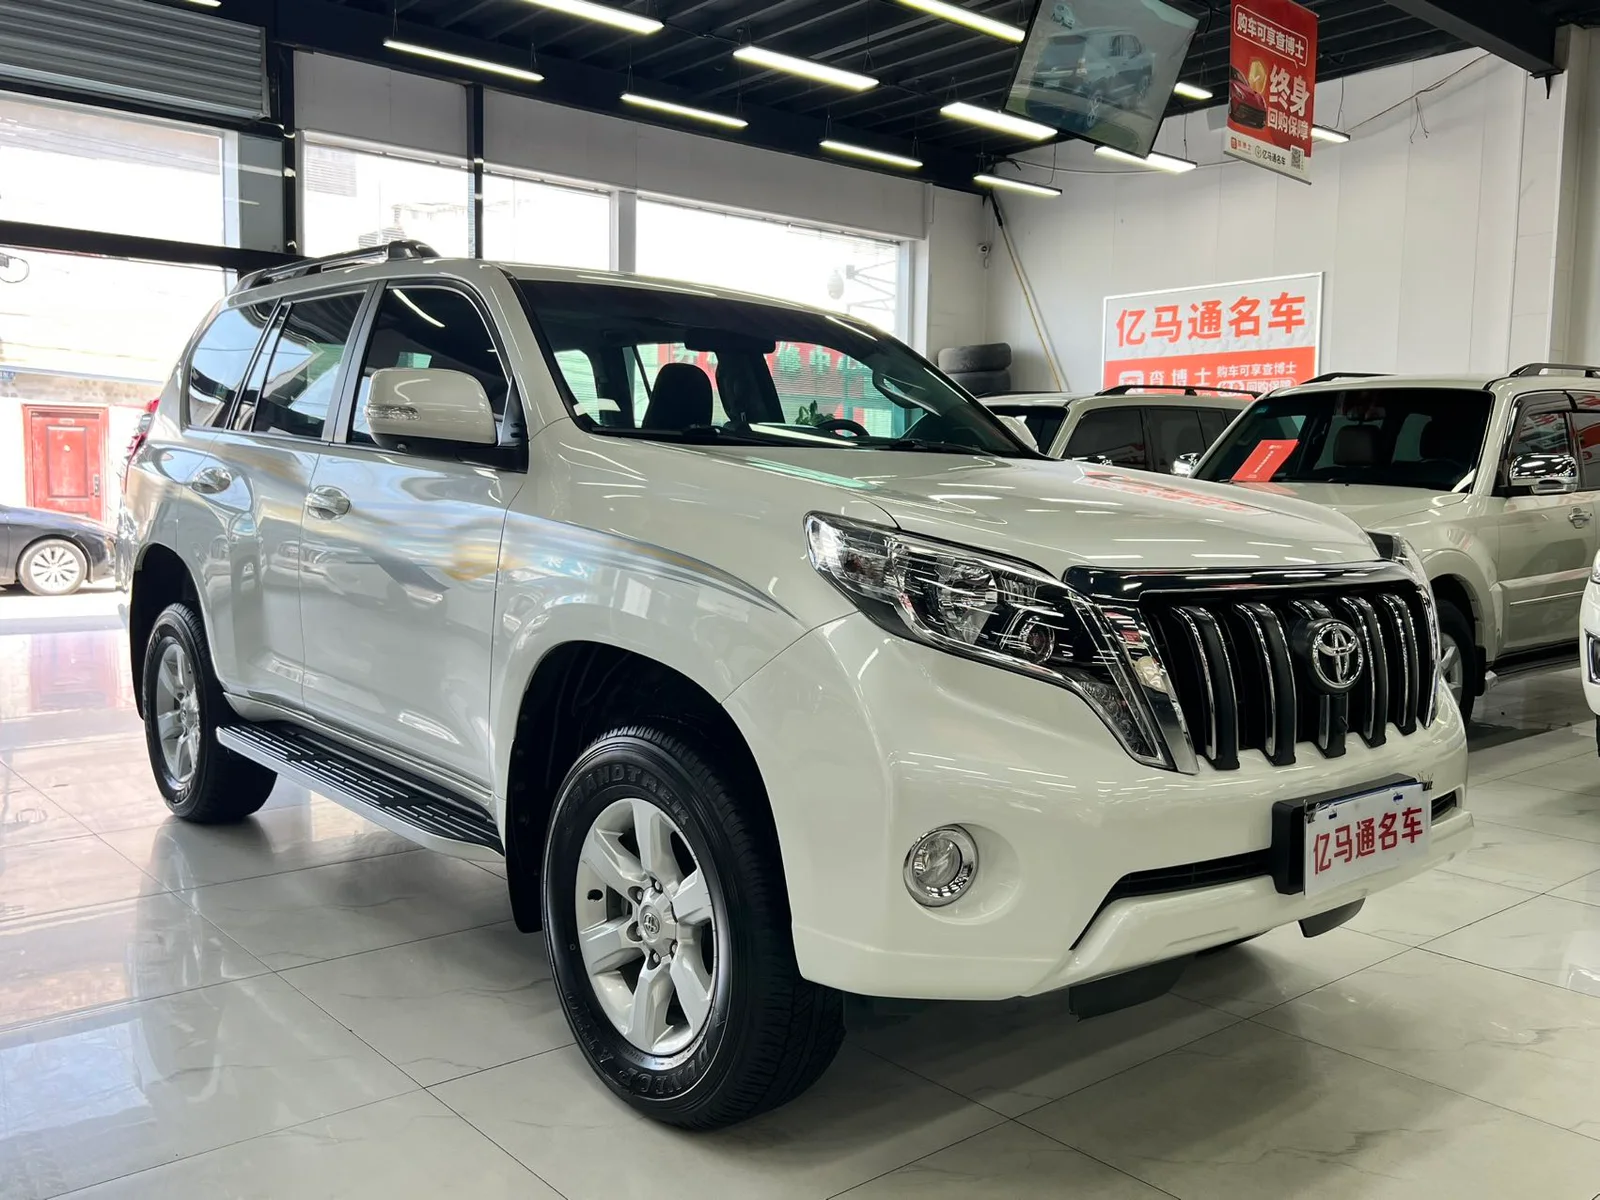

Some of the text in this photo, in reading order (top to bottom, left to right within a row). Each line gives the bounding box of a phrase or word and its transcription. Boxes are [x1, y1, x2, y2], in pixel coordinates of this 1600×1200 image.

[1237, 12, 1304, 59] 购车可享查博士
[1269, 64, 1310, 117] 终身
[1267, 107, 1308, 140] 回购保障
[1116, 292, 1306, 348] 亿马通名车
[1216, 361, 1298, 378] 购车可享查博士
[1313, 806, 1423, 875] 亿马通名车
